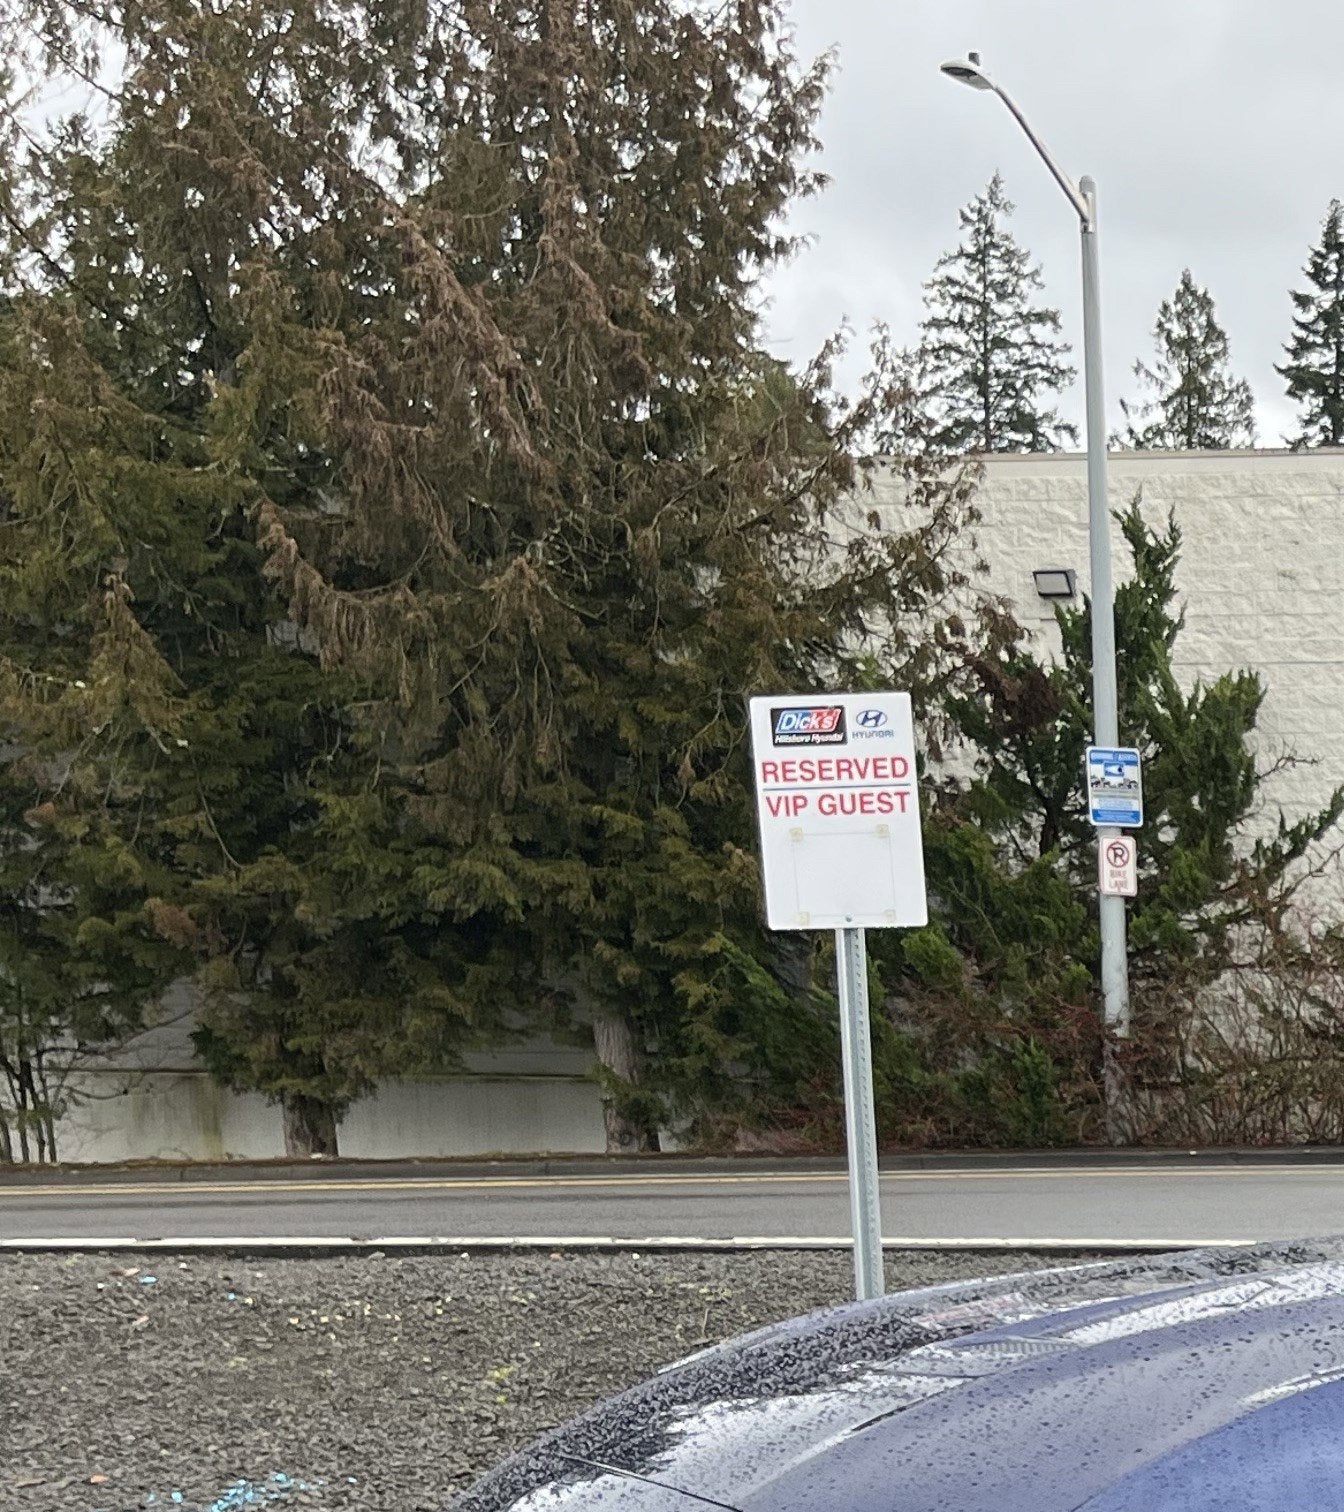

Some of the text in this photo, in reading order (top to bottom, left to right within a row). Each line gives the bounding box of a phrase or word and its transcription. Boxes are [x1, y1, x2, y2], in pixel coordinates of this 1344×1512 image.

[760, 756, 910, 783] RESERVED
[765, 790, 911, 818] VIP GUEST
